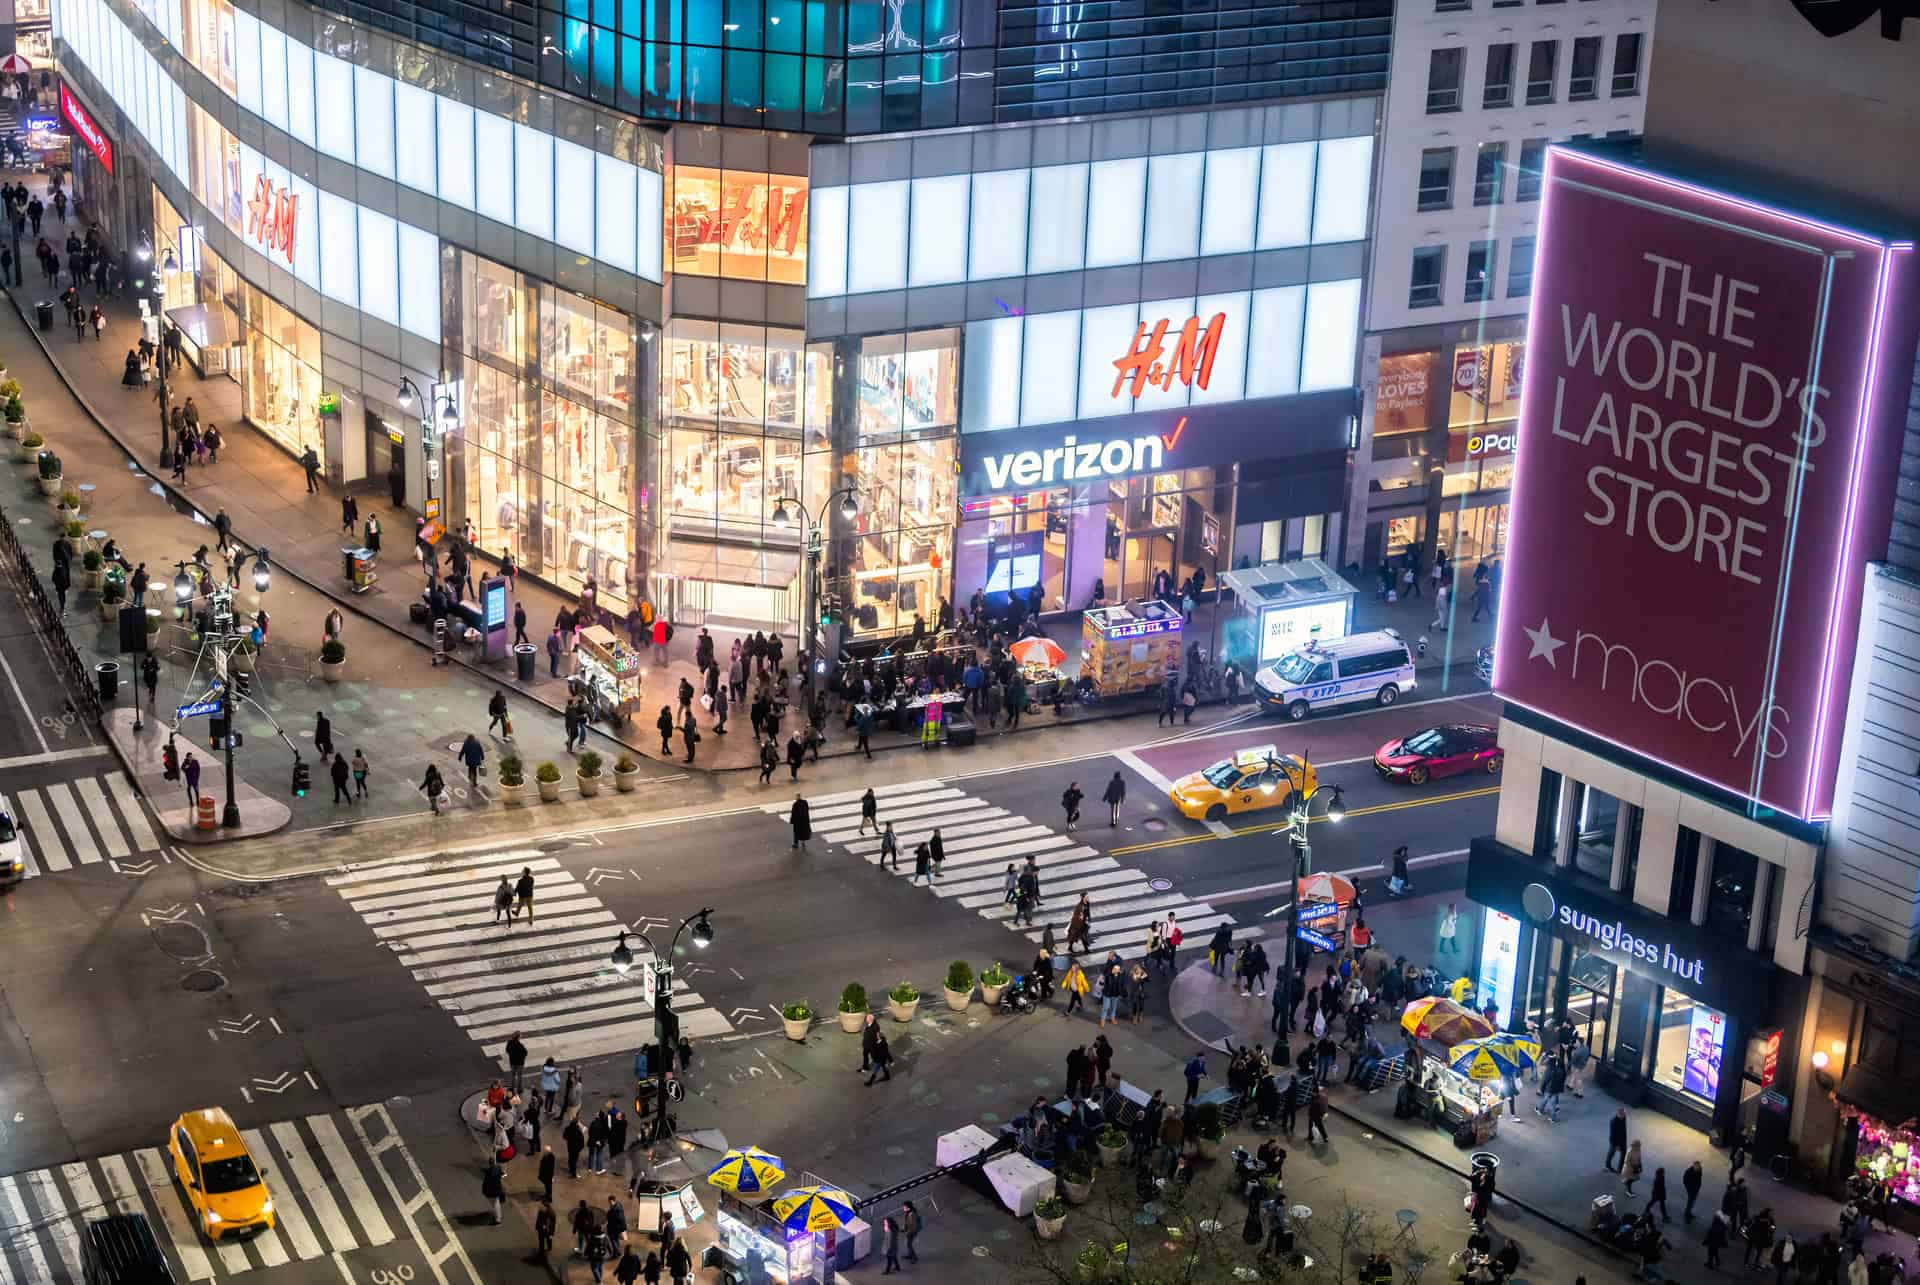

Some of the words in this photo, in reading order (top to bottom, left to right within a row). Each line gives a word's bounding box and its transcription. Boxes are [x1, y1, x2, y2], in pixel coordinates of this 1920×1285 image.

[247, 173, 298, 265] H&M
[1643, 252, 1760, 349] THE
[1111, 311, 1227, 399] H&M
[1377, 382, 1428, 399] LOVES
[1561, 303, 1831, 448] WORLD'S
[983, 435, 1163, 489] verizon
[1552, 375, 1815, 518] LARGEST
[1583, 465, 1767, 585] STORE
[1311, 685, 1342, 698] NYPD
[1559, 904, 1659, 963] sunglass
[1662, 943, 1705, 984] hut
